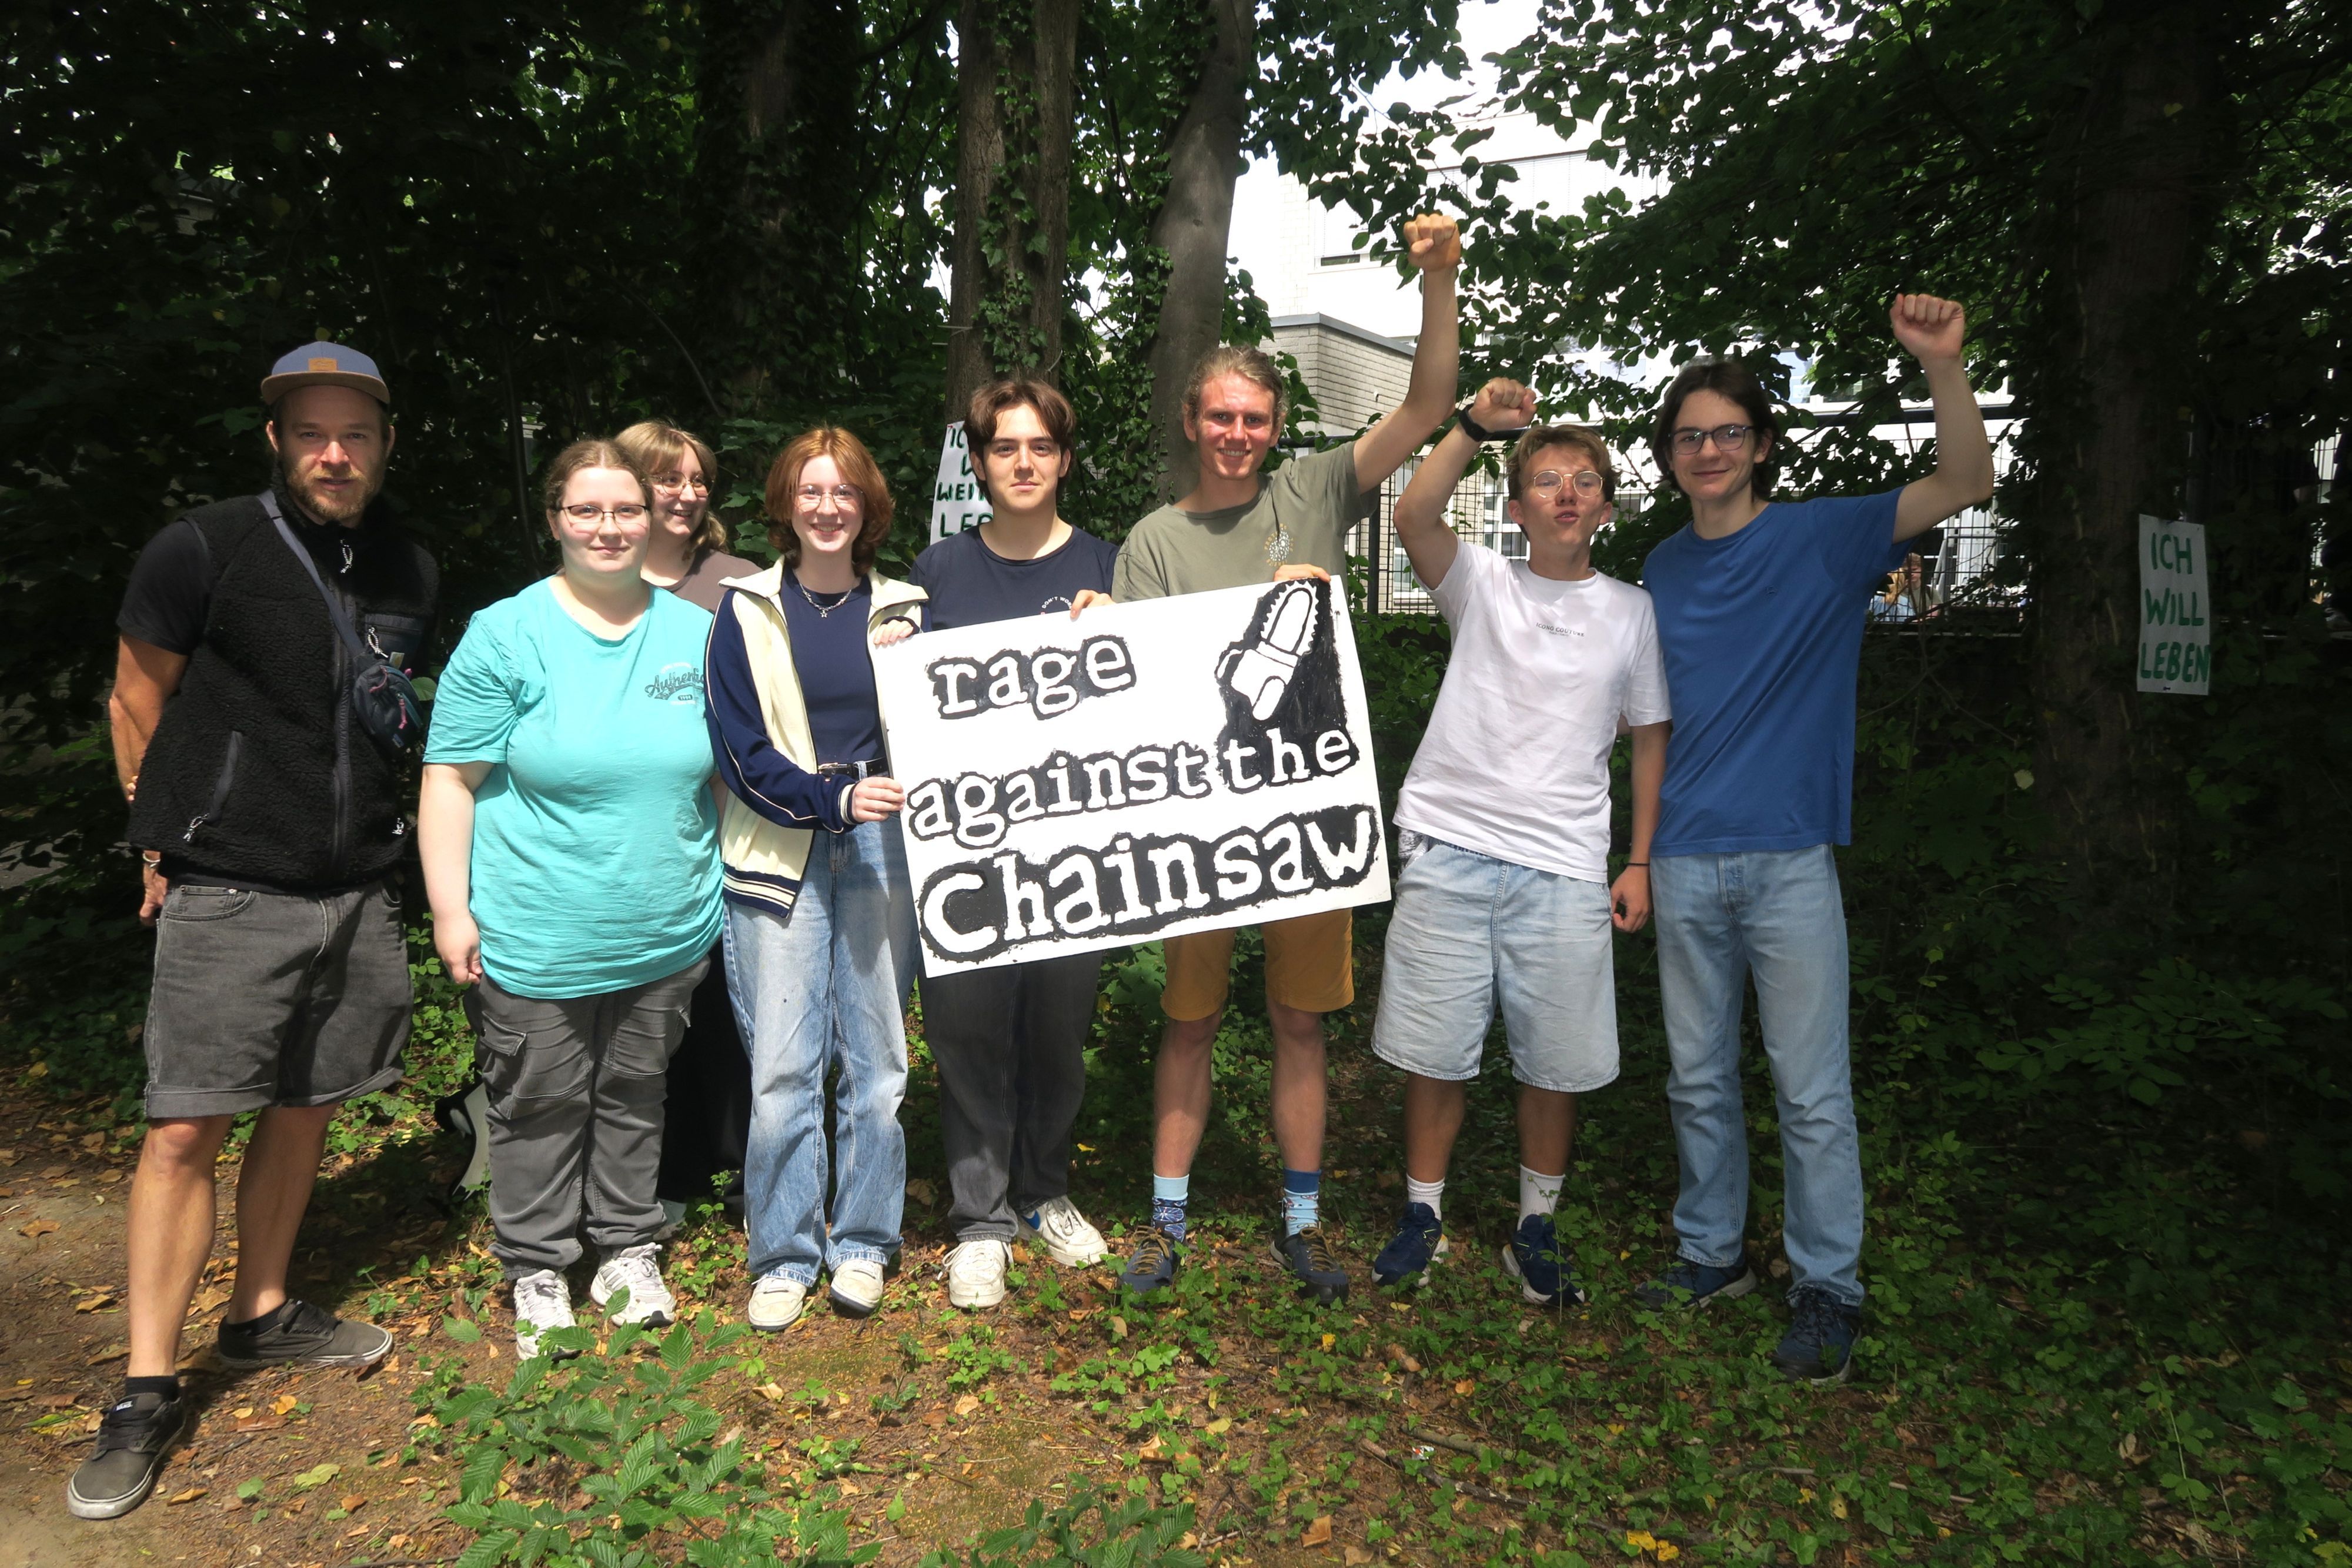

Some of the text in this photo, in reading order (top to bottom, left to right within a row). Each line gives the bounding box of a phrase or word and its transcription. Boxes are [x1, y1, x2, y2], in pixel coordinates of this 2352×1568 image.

[2151, 533, 2192, 574] ICH
[1041, 596, 1058, 609] DON'T
[2145, 588, 2204, 626] WILL
[1555, 627, 1585, 637] COUTURE
[929, 637, 1135, 718] rage
[2141, 641, 2211, 683] LEBEN
[908, 728, 1359, 848] against the
